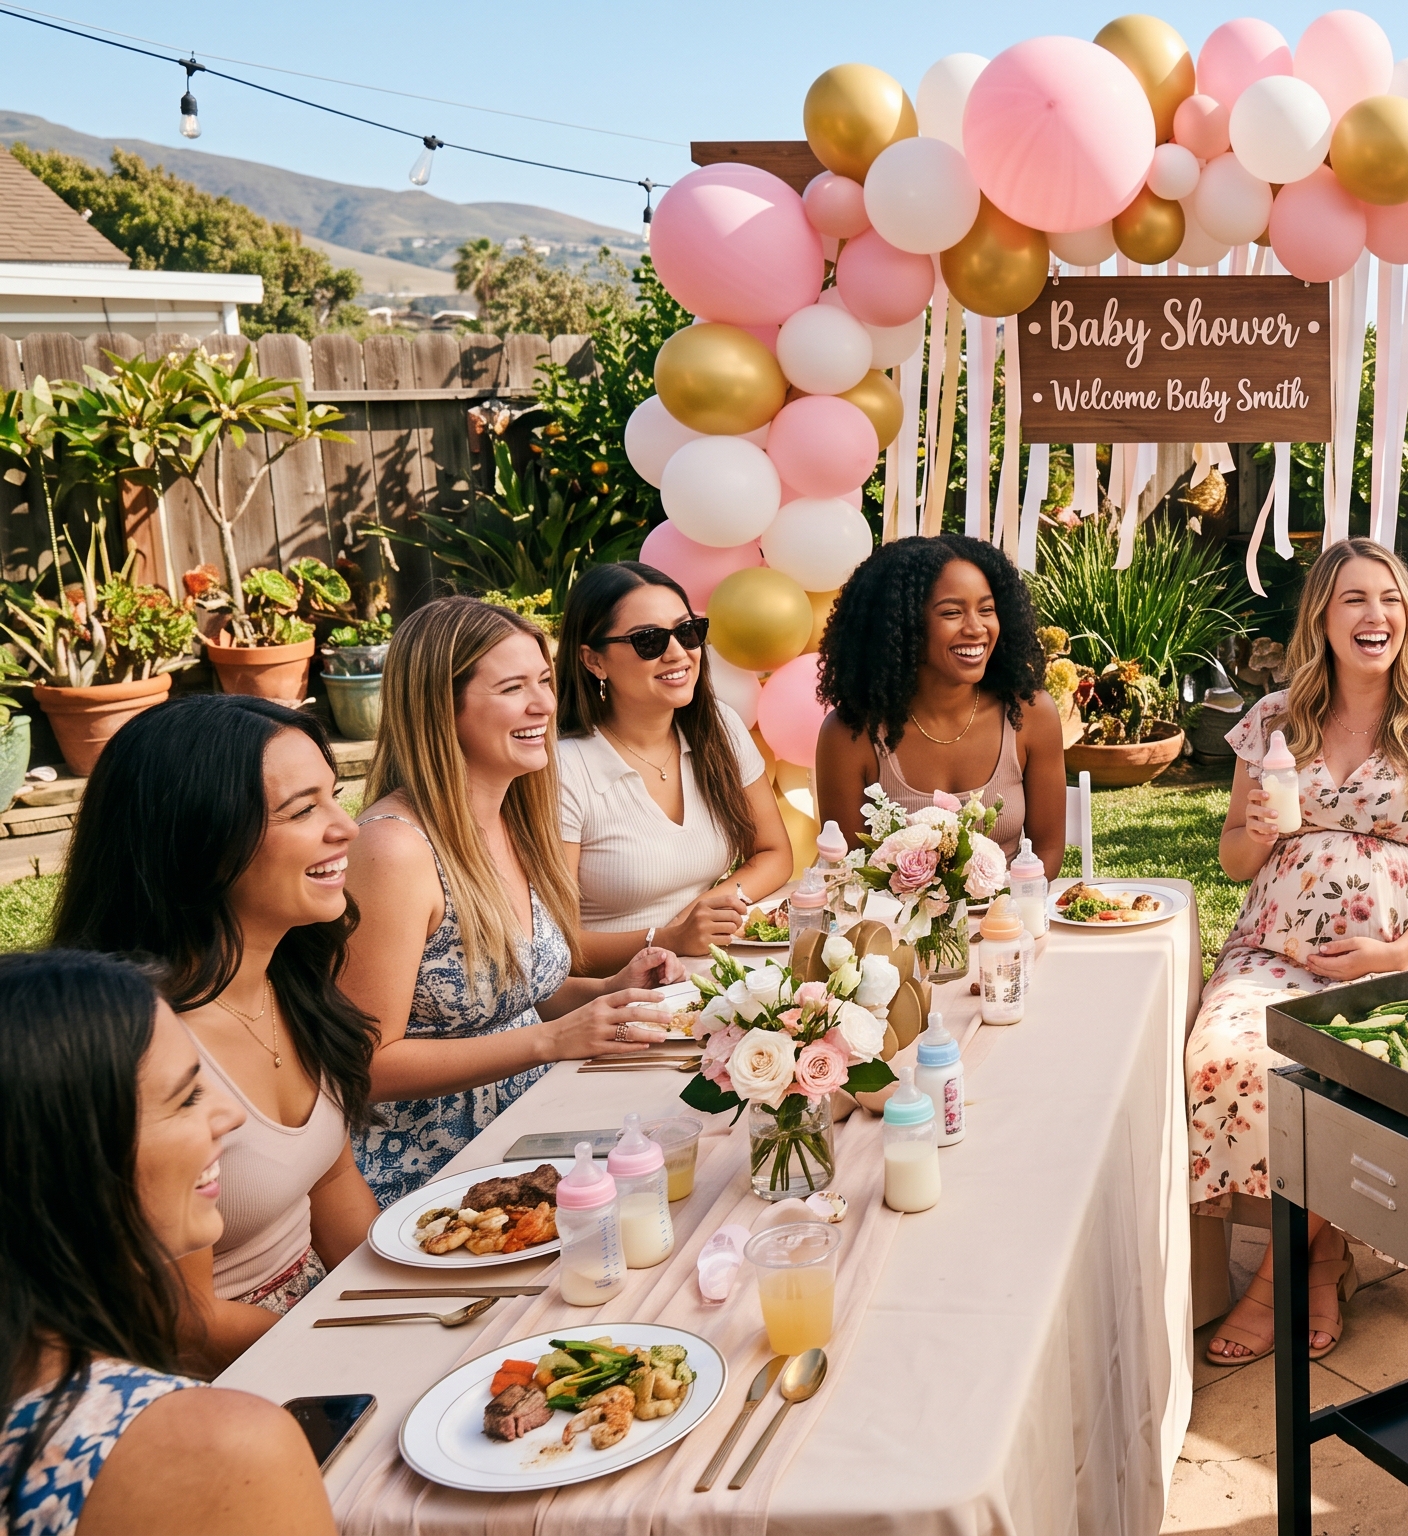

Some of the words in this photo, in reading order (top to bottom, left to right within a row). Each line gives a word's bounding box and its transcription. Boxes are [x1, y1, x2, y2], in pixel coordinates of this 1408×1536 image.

[1050, 297, 1152, 369] Baby
[1160, 297, 1301, 351] Shower
[1050, 378, 1161, 411] Welcome
[1167, 377, 1232, 424] Baby
[1236, 377, 1310, 411] Smith
